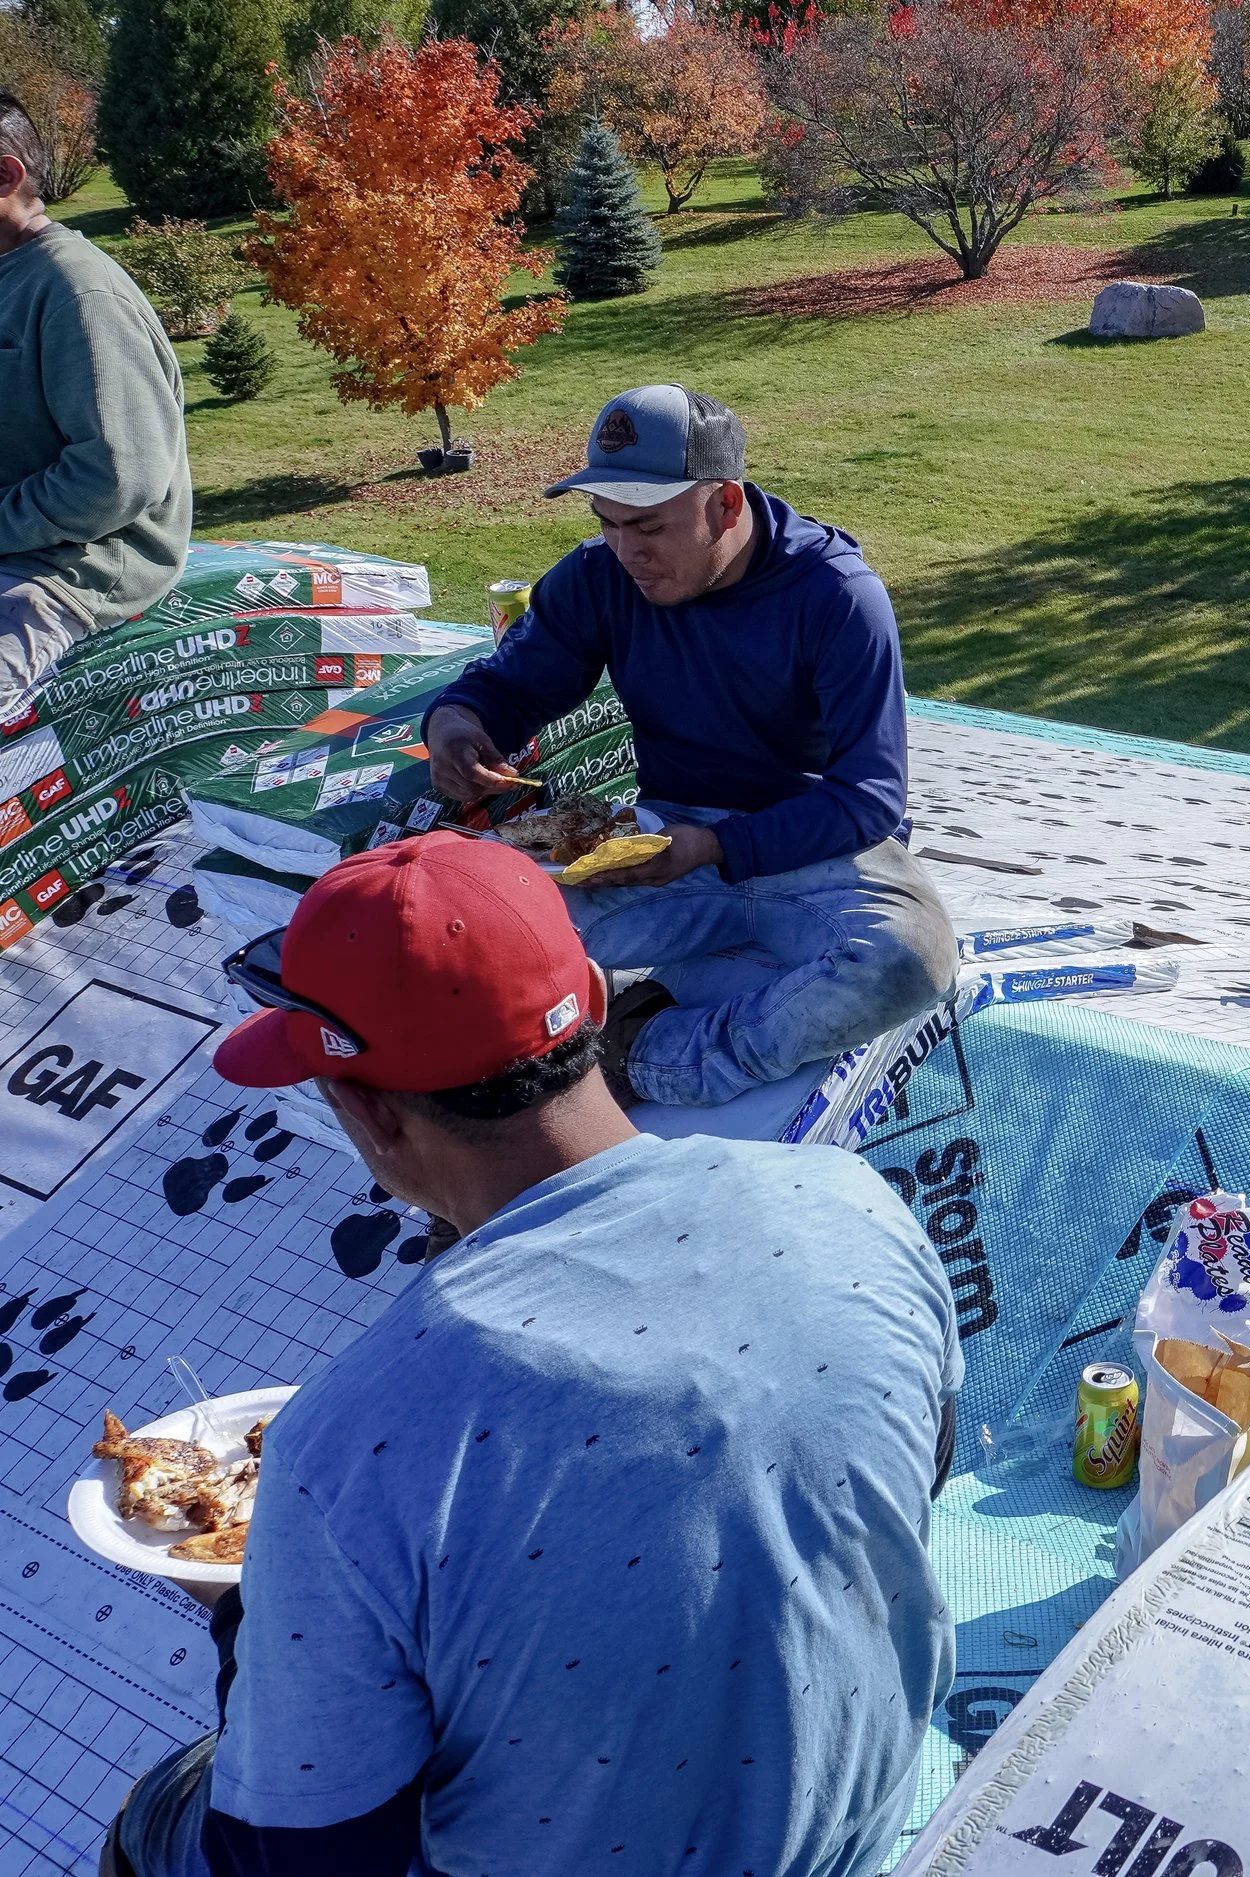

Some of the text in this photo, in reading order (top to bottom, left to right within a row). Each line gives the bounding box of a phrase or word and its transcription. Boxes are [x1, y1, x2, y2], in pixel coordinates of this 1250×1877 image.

[43, 647, 176, 706] Timberline
[195, 664, 311, 692] Timberline
[318, 666, 343, 675] GAF
[356, 669, 382, 682] MC
[4, 704, 34, 728] GAF
[73, 709, 194, 776] Timberline
[508, 741, 537, 766] GAF
[545, 738, 639, 802] Timberli
[38, 777, 66, 802] GAF
[0, 785, 133, 886] erline UHDZ
[61, 796, 184, 876] Timberline
[71, 826, 108, 850] Shingles
[136, 824, 158, 840] Ultra
[36, 878, 64, 904] GAF
[983, 931, 1021, 947] SHINGLE
[1011, 973, 1095, 994] SHINGLE STARTER
[8, 1044, 148, 1122] GAF
[915, 1137, 999, 1341] Storm
[1189, 1216, 1235, 1298] Plates
[1087, 1397, 1136, 1476] Squirt
[130, 1571, 157, 1589] ONLY
[151, 1580, 182, 1603] Plastic
[179, 1596, 198, 1615] Cap
[1153, 1617, 1190, 1637] inicial
[1164, 1607, 1240, 1643] Instrucciones
[1189, 1630, 1224, 1649] hilera
[1223, 1643, 1236, 1654] la
